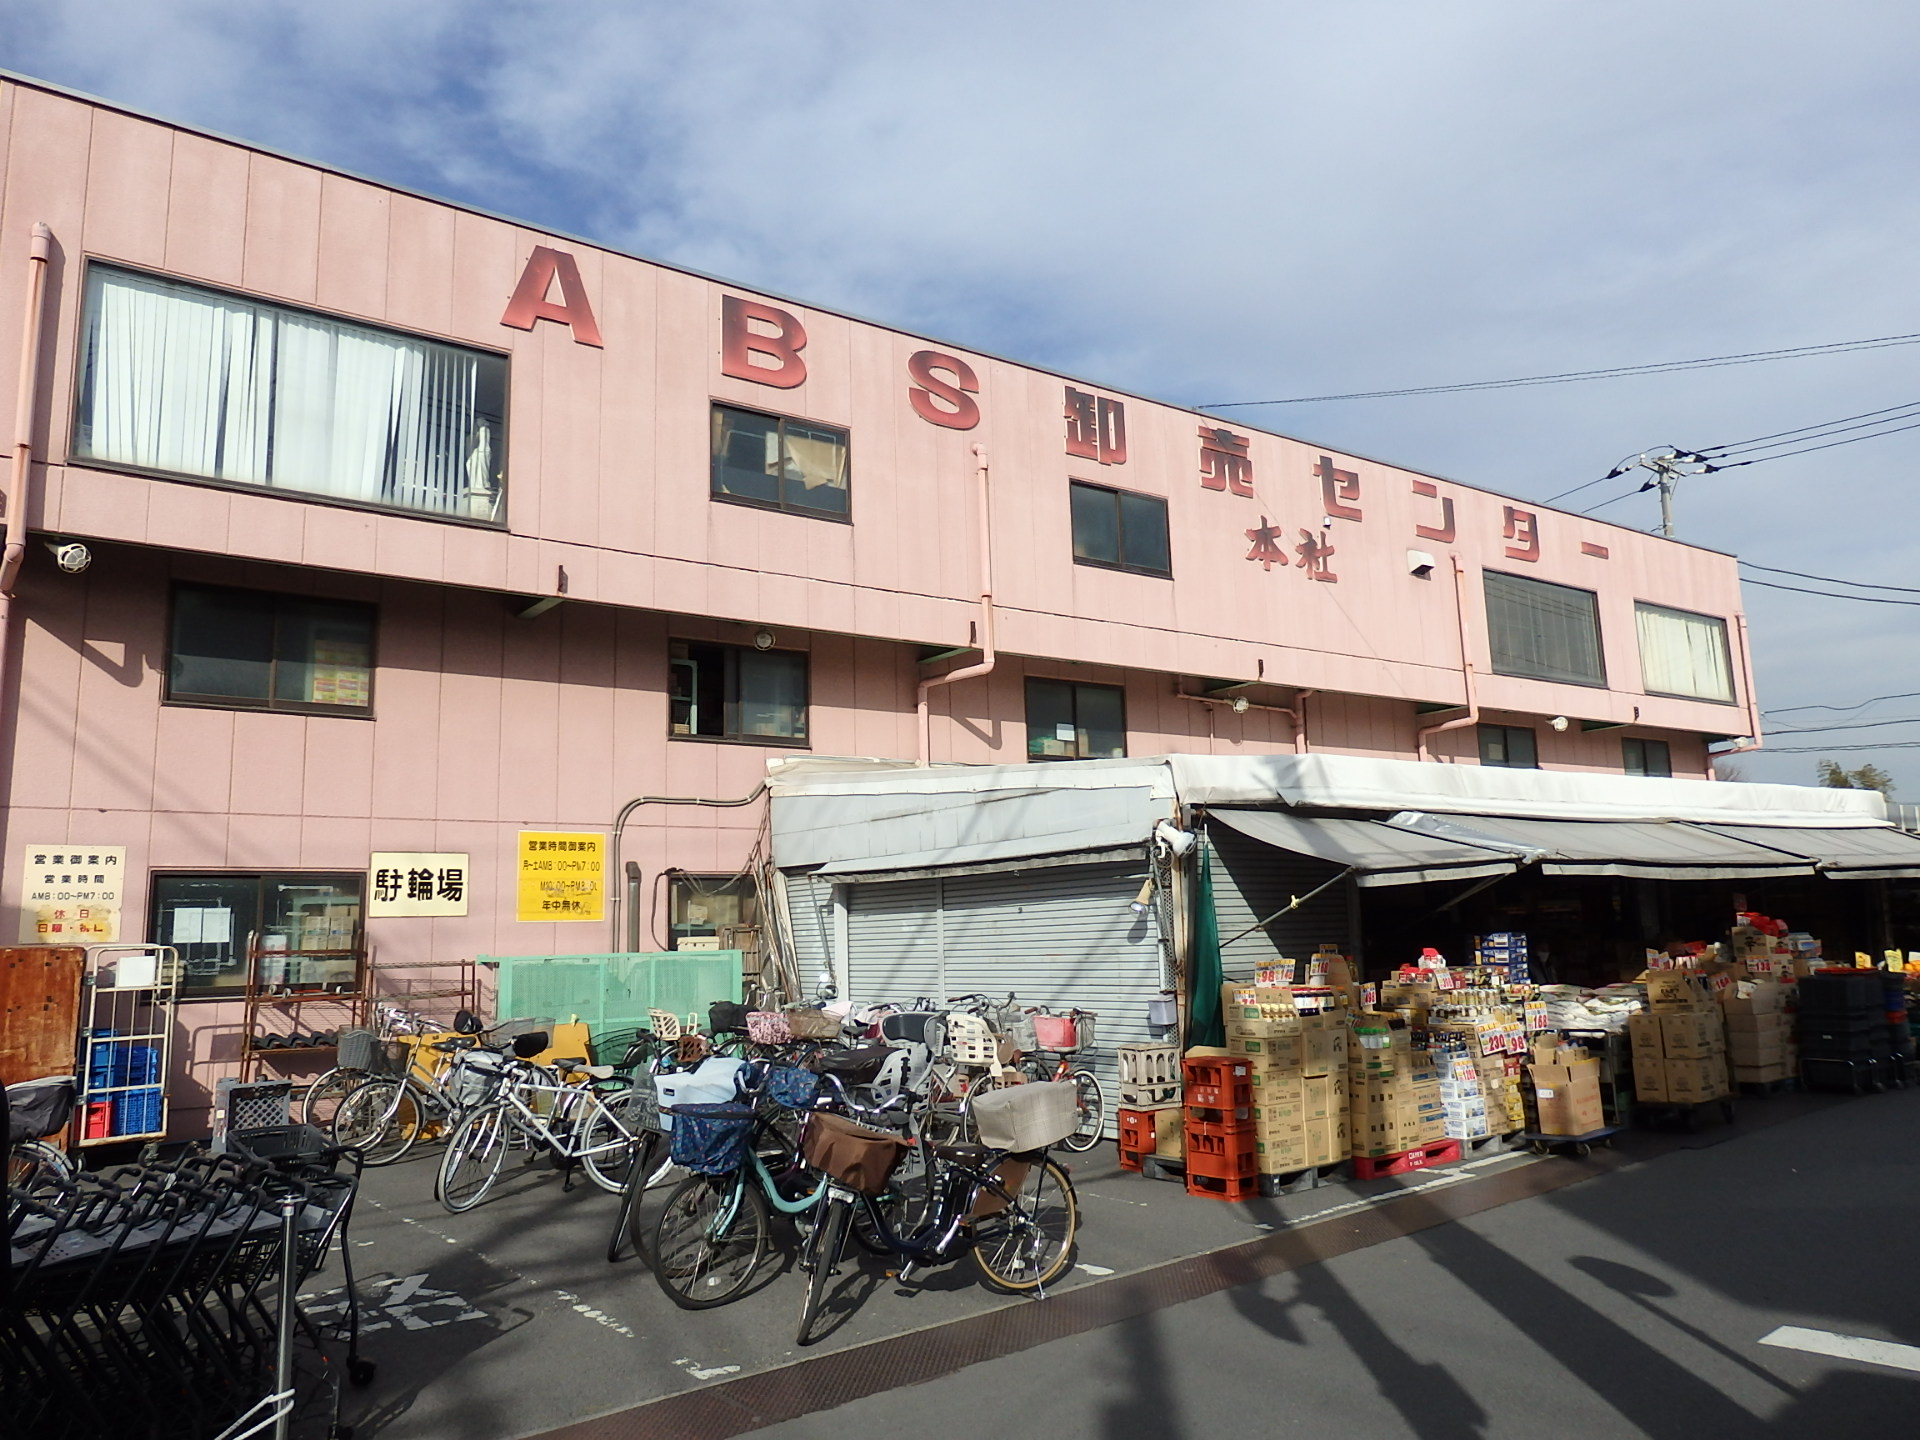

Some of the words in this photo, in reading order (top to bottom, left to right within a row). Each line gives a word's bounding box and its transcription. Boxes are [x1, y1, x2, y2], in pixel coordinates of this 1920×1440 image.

[500, 245, 981, 431] ABS
[1063, 385, 1610, 563] 卸売センター
[1245, 515, 1338, 584] 本社
[528, 840, 596, 852] 営業時間御案内
[34, 854, 117, 866] 営業御案内
[44, 874, 105, 884] 営業時間
[374, 868, 464, 902] 駐輪場
[542, 900, 581, 911] 年中無休
[1261, 970, 1275, 983] 98
[1533, 1015, 1547, 1029] 168
[1488, 1034, 1506, 1052] 230
[1511, 1036, 1525, 1052] 98
